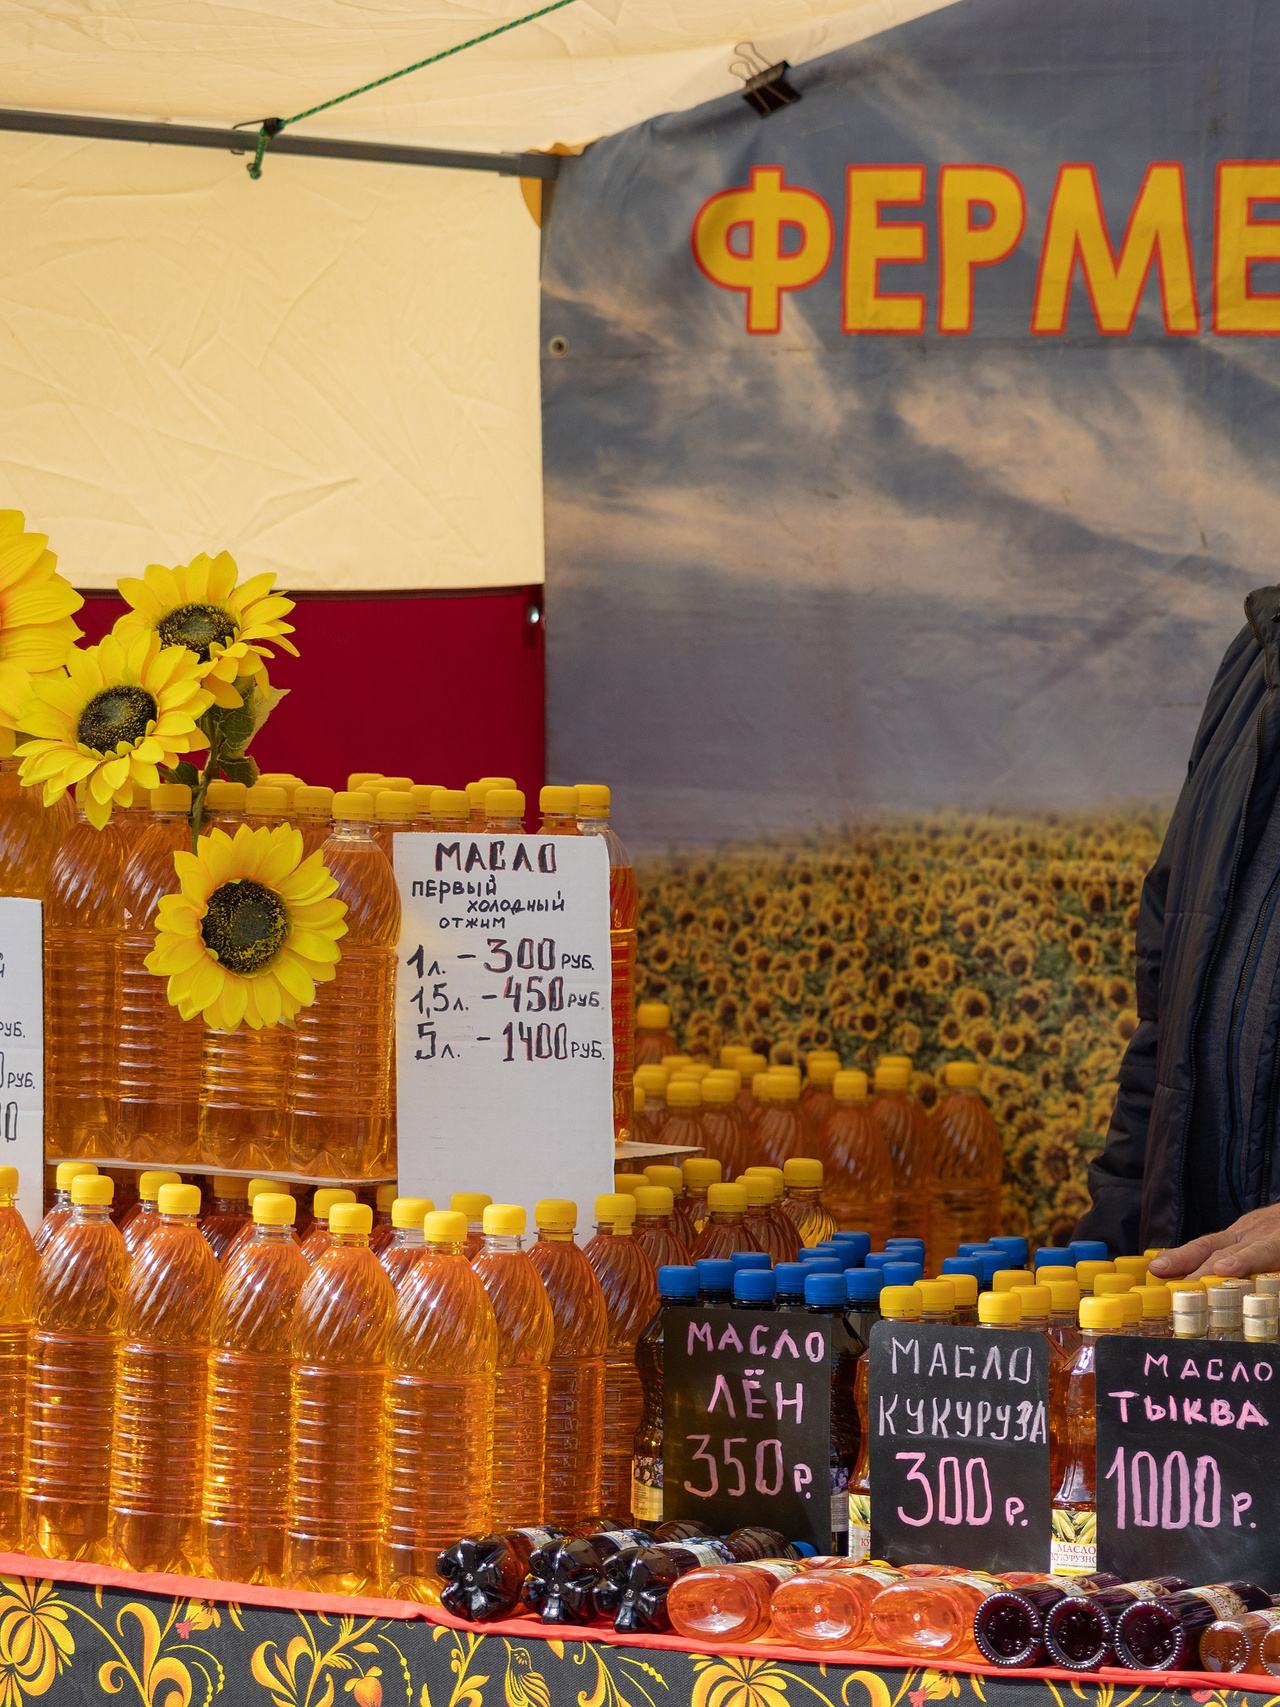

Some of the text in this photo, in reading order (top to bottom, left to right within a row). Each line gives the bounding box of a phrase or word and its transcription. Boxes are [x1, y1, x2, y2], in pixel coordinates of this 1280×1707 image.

[435, 841, 557, 873] МАСЛО
[412, 875, 497, 904] ПЕРВЫЙ
[439, 917, 506, 929] ОТЖИМ
[687, 1321, 825, 1363] МАСЛО
[891, 1337, 1032, 1384] МАСЛО
[1143, 1352, 1273, 1382] МАСЛО
[707, 1369, 804, 1424] ЛЁН
[1107, 1390, 1270, 1430] ТЫКВА
[878, 1393, 1047, 1444] КУКУРУЗА
